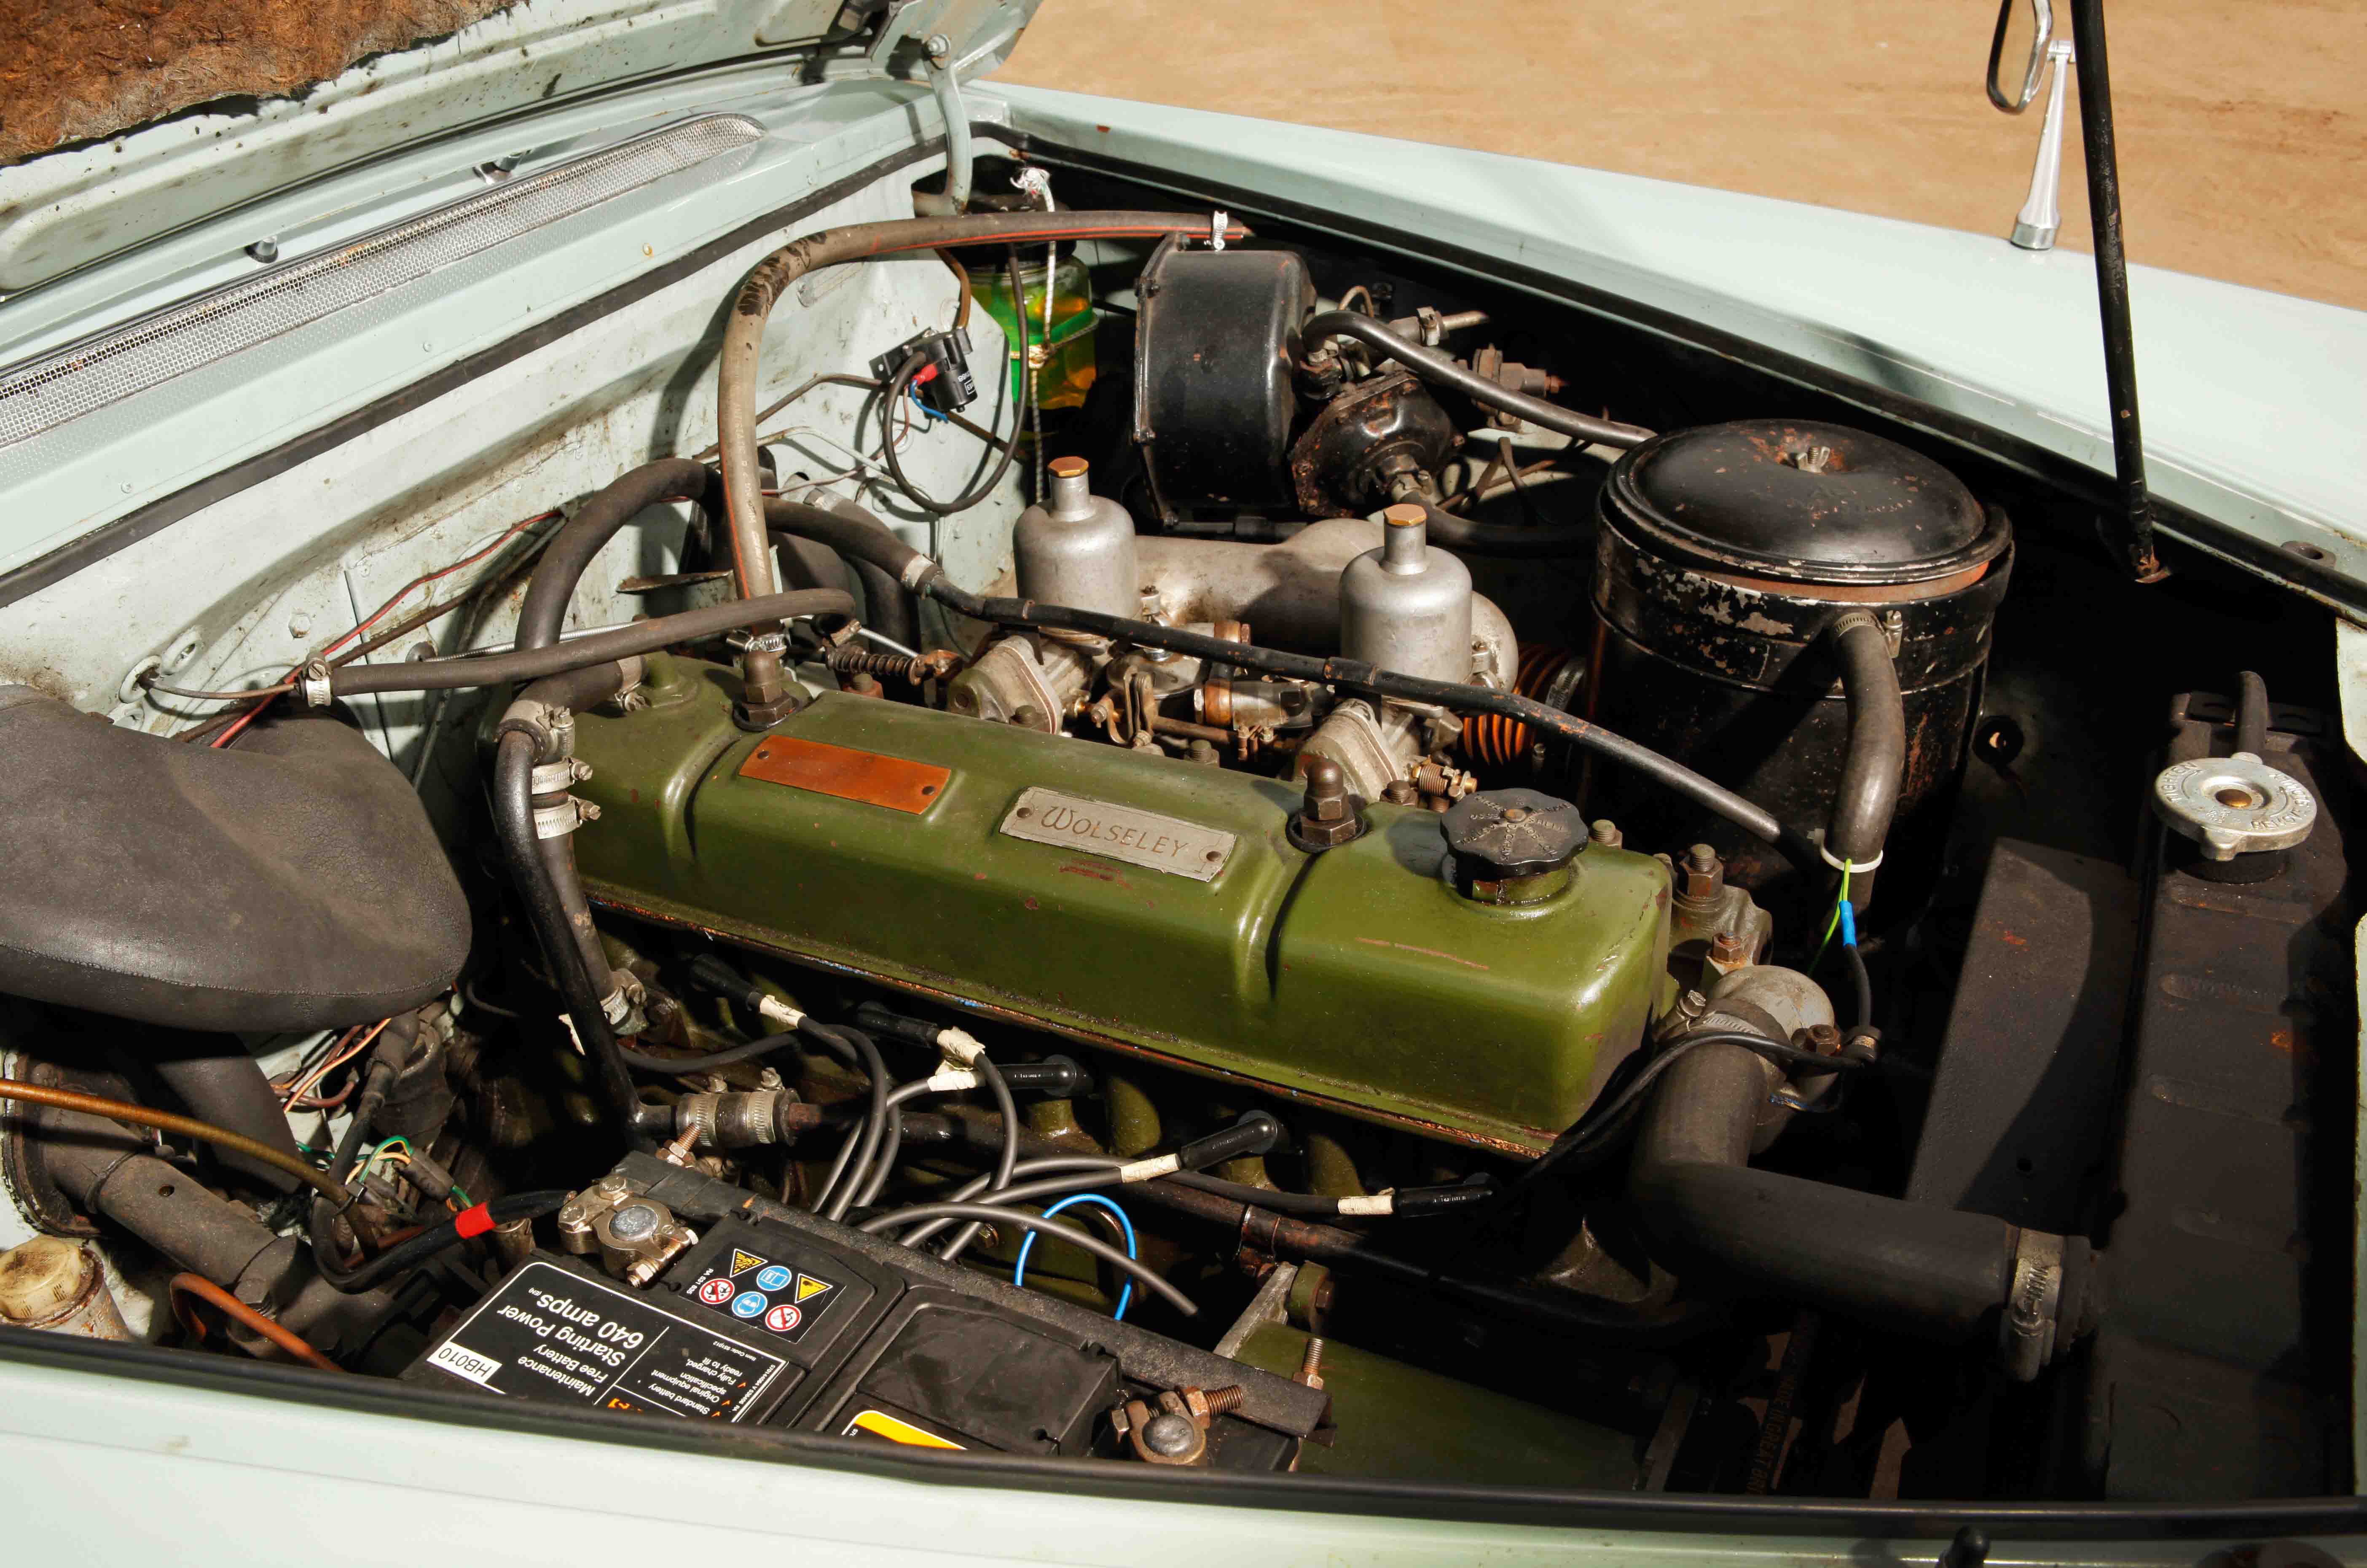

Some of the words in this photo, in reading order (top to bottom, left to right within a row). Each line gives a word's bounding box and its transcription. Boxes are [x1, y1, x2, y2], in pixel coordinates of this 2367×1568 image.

[1041, 806, 1188, 857] WOLSELEY
[497, 1305, 556, 1337] Power
[537, 1295, 600, 1326] amps
[555, 1326, 625, 1366] Starting
[598, 1322, 644, 1348] 640
[438, 1348, 491, 1377] HB010
[533, 1345, 580, 1371] Battery
[730, 1348, 745, 1356] Code:
[518, 1357, 595, 1396] Maintenance
[579, 1365, 608, 1383] Free
[686, 1359, 717, 1375] charged,
[720, 1364, 743, 1377] ready
[651, 1370, 690, 1389] equipment
[680, 1372, 726, 1395] specification
[717, 1373, 736, 1385] Fully
[648, 1384, 675, 1399] battery
[689, 1386, 719, 1403] Original
[671, 1393, 710, 1414] Standard
